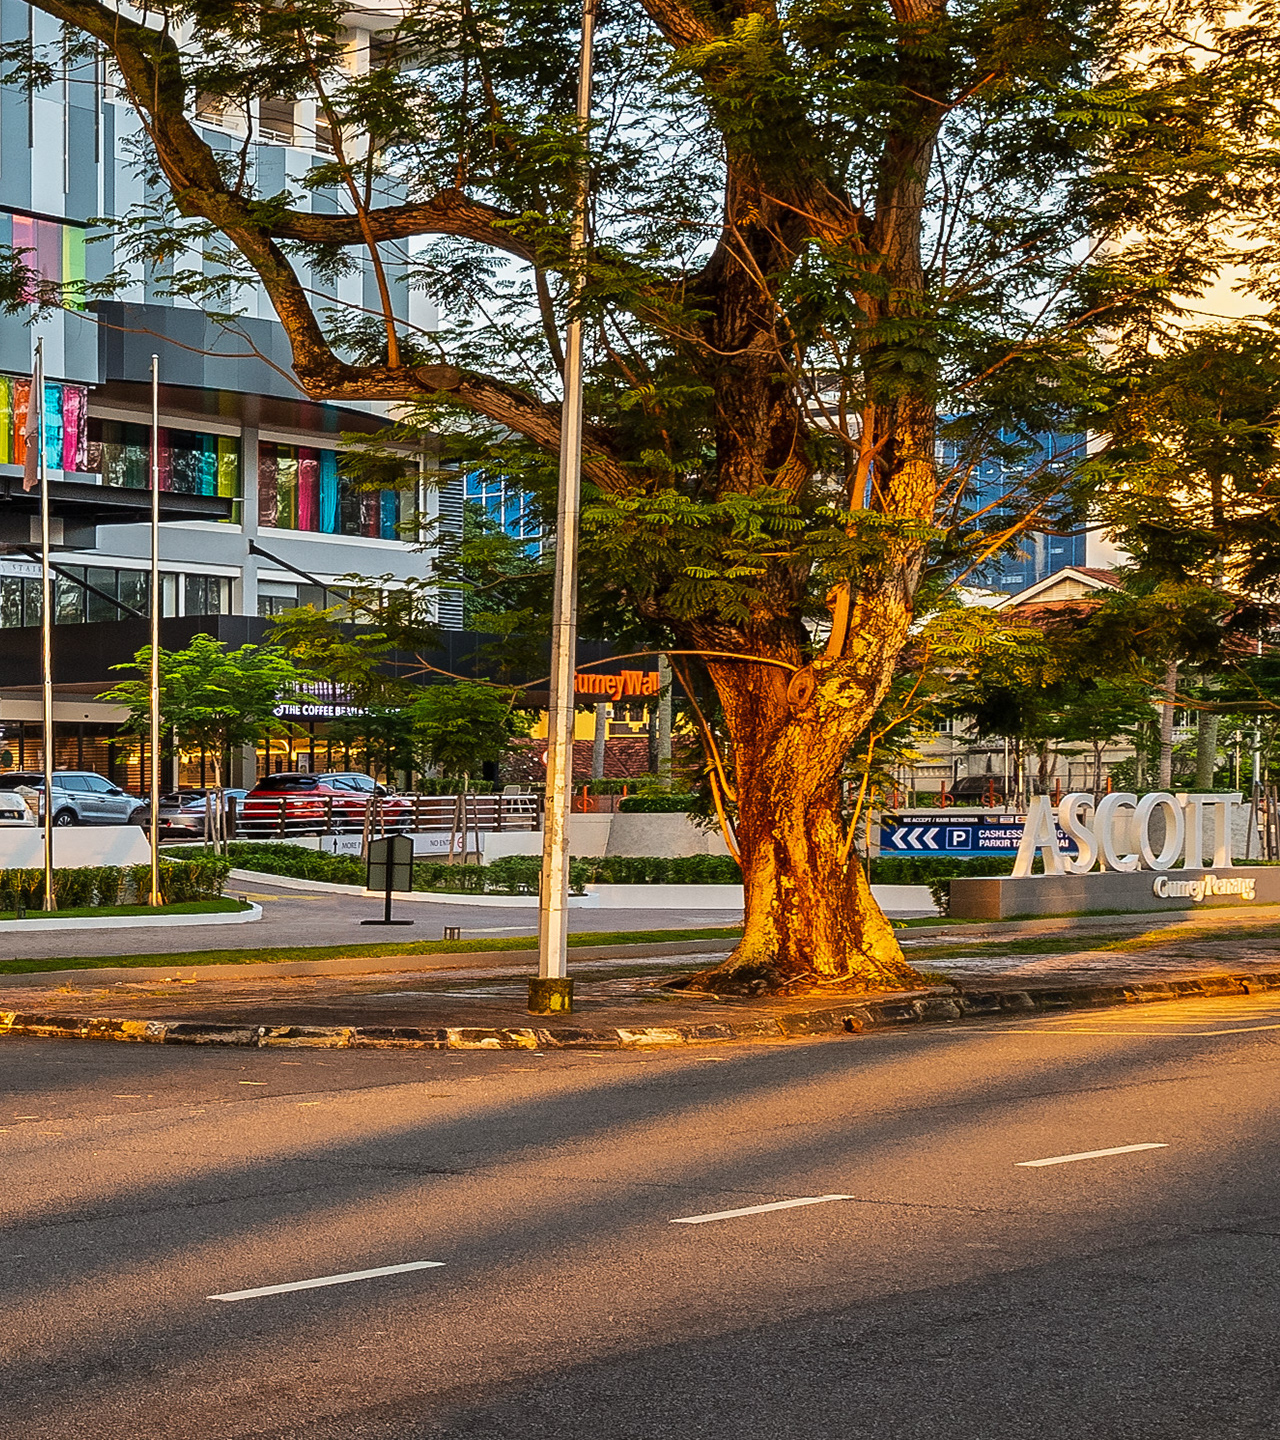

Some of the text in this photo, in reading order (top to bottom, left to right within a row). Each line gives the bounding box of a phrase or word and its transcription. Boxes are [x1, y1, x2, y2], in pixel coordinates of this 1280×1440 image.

[302, 705, 333, 716] COFFEE
[953, 831, 966, 845] P
[979, 829, 1023, 838] CASHLESS
[1012, 792, 1243, 877] ASCOTT
[979, 839, 1011, 847] PARKIR
[1204, 874, 1256, 900] Penang
